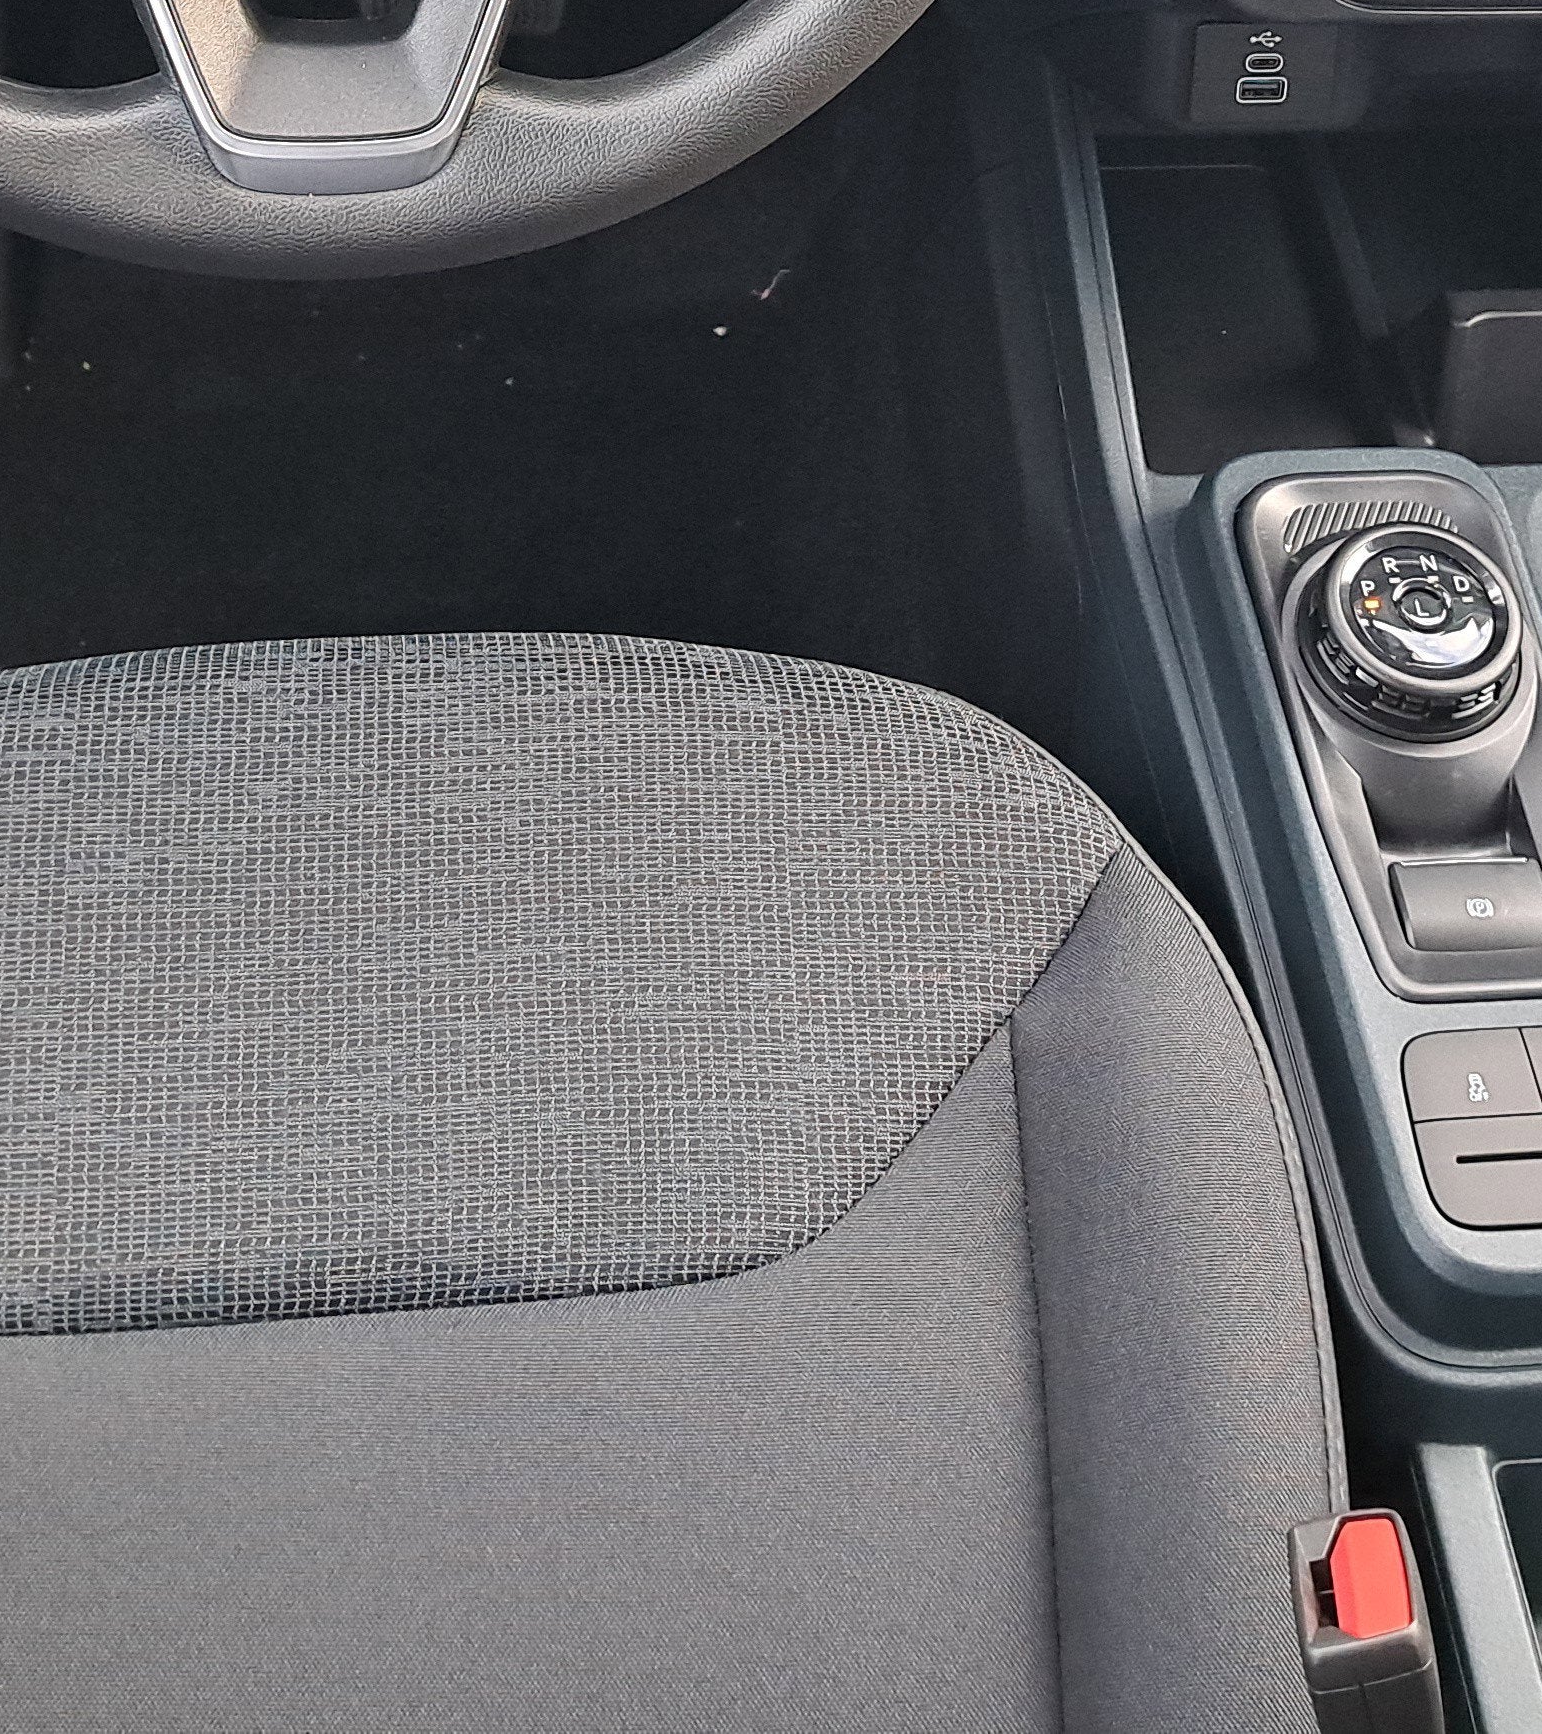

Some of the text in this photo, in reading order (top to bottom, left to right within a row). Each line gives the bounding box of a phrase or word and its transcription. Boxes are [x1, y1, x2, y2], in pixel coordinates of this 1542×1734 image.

[1381, 556, 1400, 574] R
[1419, 554, 1439, 572] N
[1359, 579, 1376, 597] P
[1452, 575, 1471, 593] D
[1414, 598, 1430, 617] L
